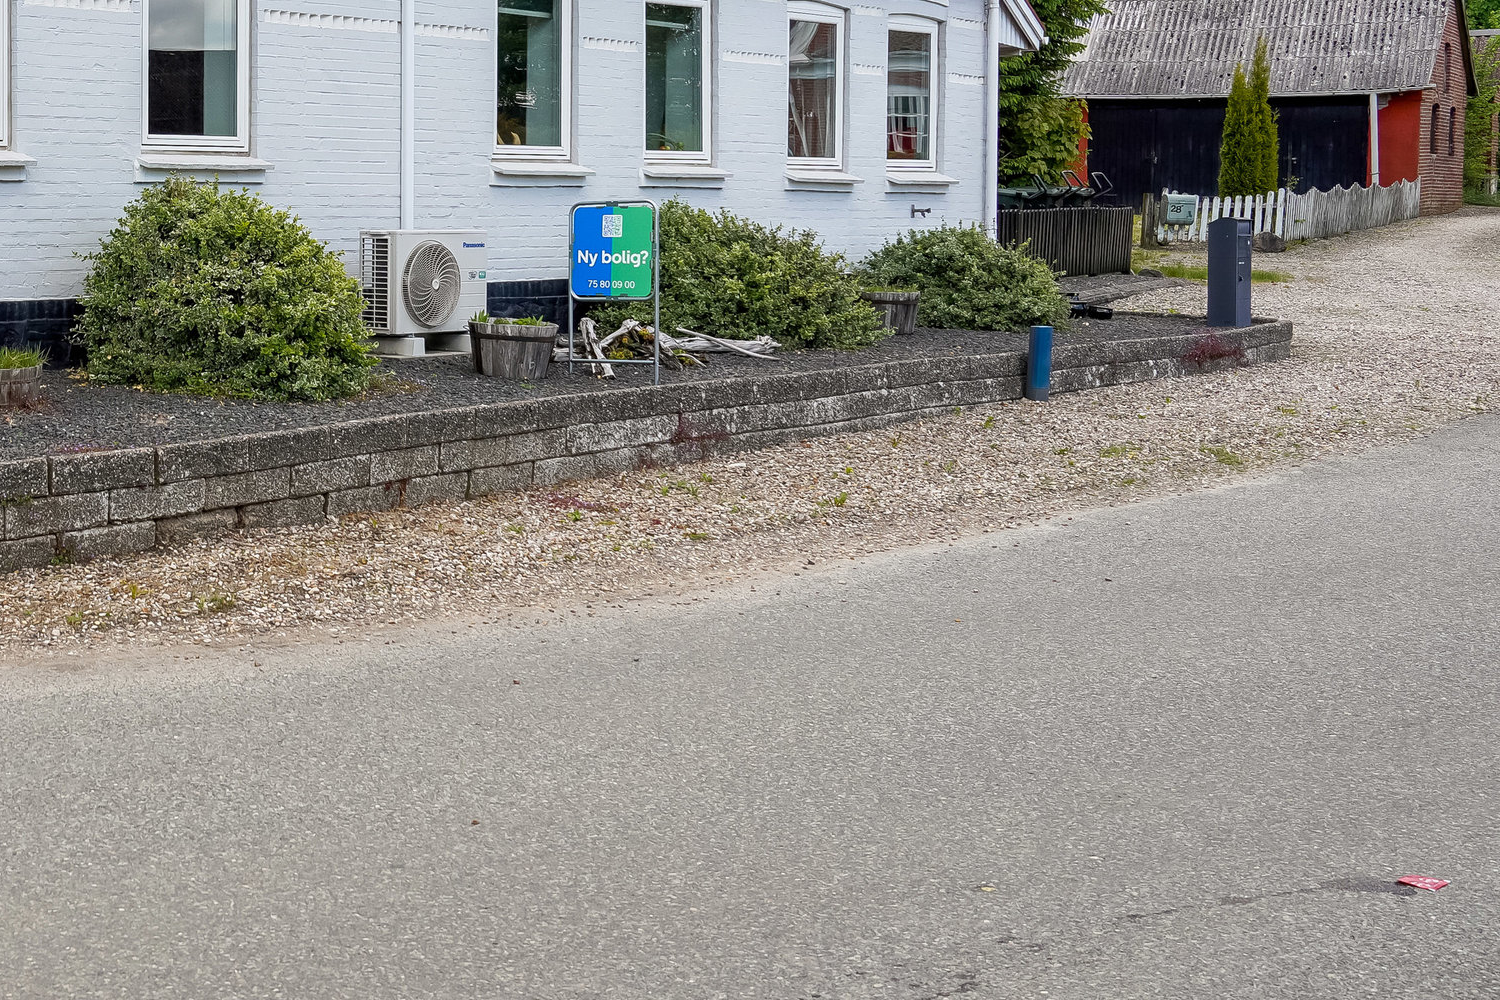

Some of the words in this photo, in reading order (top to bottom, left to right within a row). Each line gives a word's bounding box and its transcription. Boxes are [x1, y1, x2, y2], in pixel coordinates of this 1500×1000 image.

[577, 249, 598, 267] Ny
[601, 249, 649, 268] bolig?
[587, 280, 598, 288] 75
[599, 280, 610, 288] 80
[612, 280, 623, 289] 09
[624, 280, 636, 289] 00
